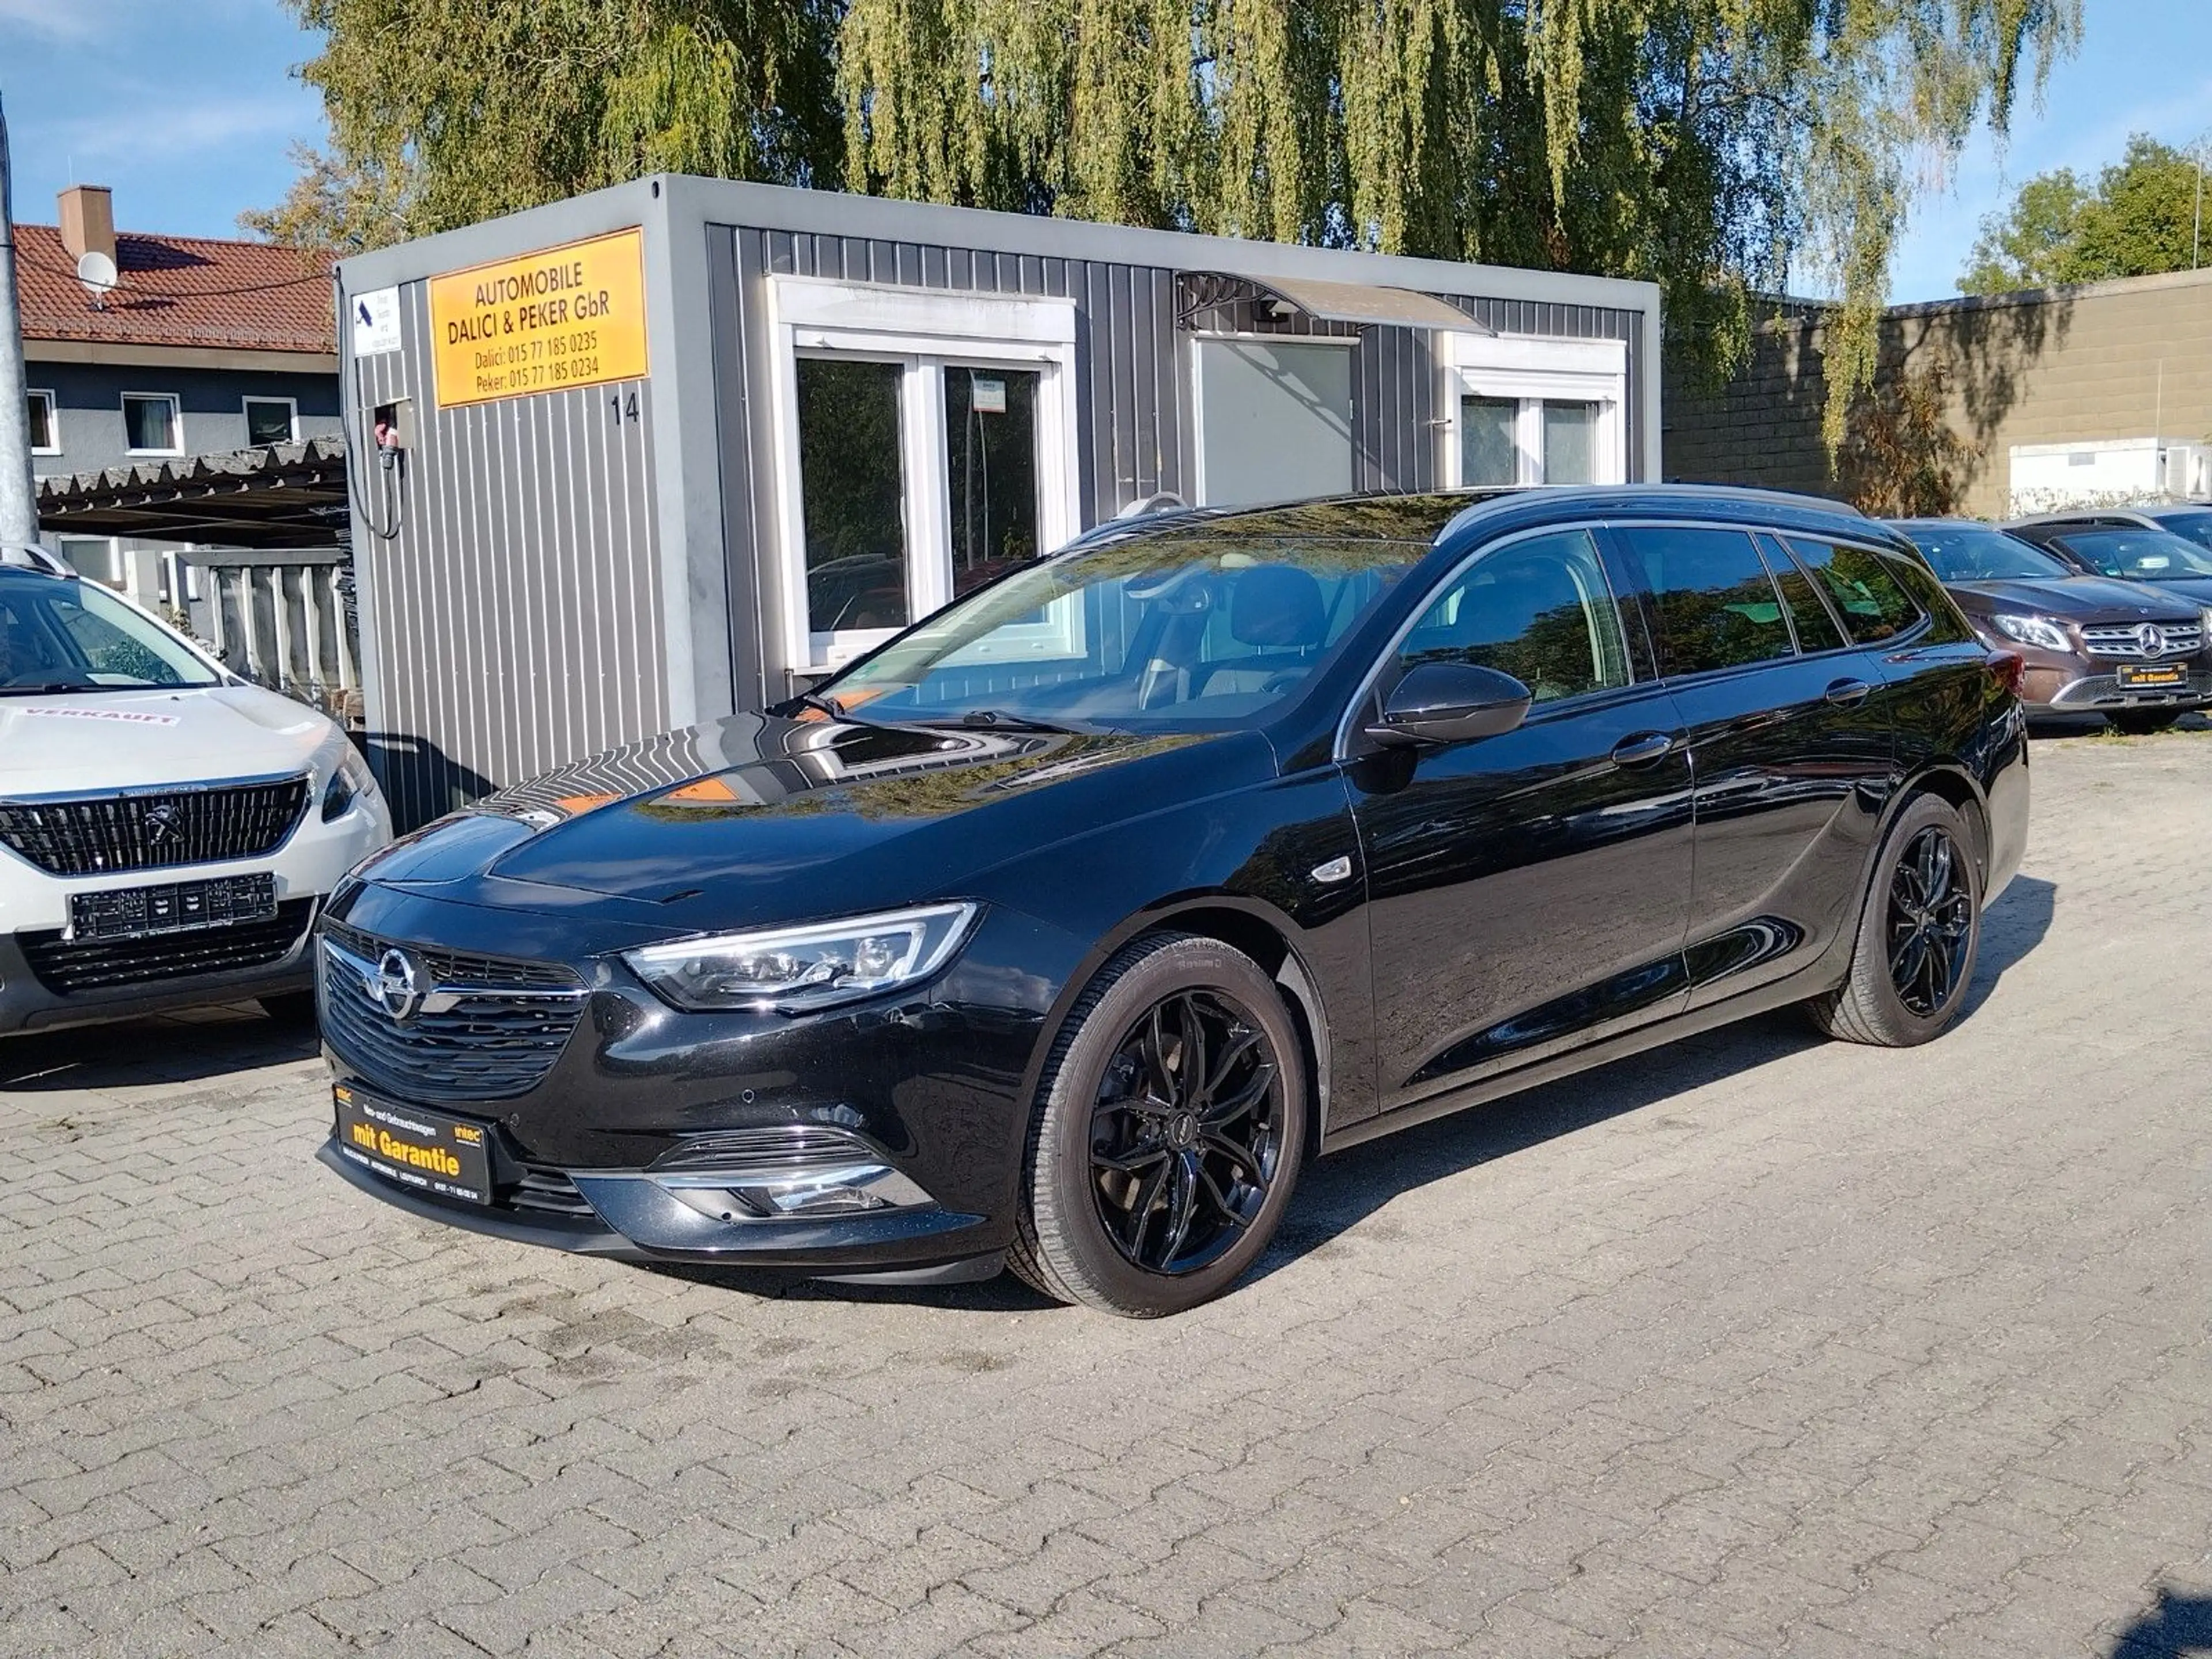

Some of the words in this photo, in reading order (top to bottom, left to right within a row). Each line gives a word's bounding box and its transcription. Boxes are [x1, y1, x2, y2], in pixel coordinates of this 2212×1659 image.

[475, 262, 582, 308] AUTOMOBILE
[448, 312, 497, 344] DALICI
[503, 310, 514, 334] &
[519, 298, 569, 331] PEKER
[574, 290, 609, 320] GbR
[475, 347, 506, 369] Dalici:
[508, 343, 527, 363] 015
[531, 340, 543, 359] 77
[548, 336, 566, 357] 185
[570, 330, 597, 353] 0235
[476, 372, 507, 393] Peker:
[509, 368, 529, 388] 015
[532, 365, 544, 384] 77
[549, 361, 567, 381] 185
[571, 356, 599, 378] 0234
[611, 392, 639, 425] 14
[26, 709, 173, 723] VERKAUFT
[354, 1123, 377, 1150] mit
[379, 1130, 460, 1176] Garantie
